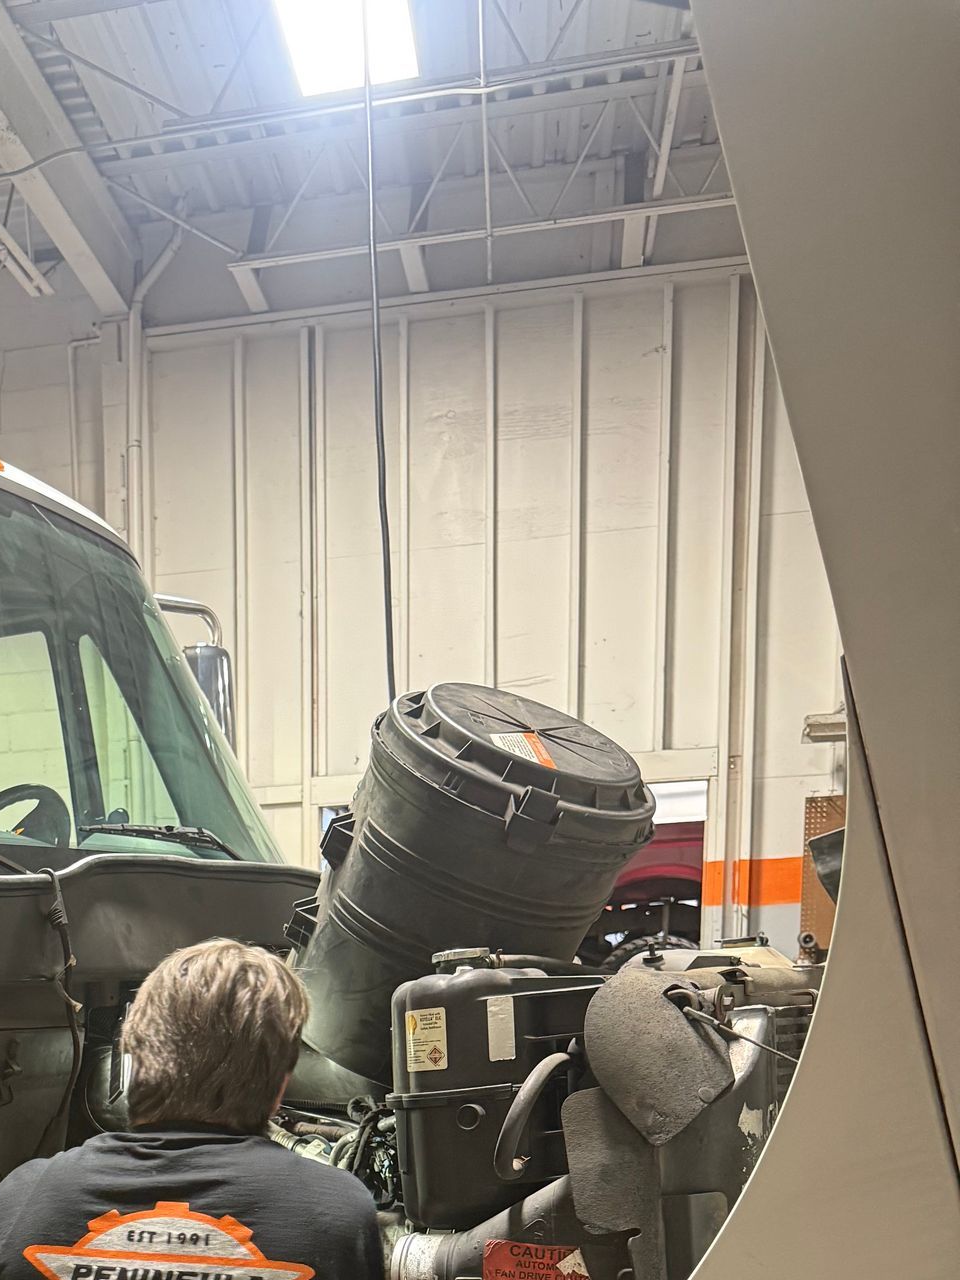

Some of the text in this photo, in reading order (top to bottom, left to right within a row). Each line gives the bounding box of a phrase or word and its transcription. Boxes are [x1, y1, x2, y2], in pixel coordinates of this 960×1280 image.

[127, 1229, 210, 1246] EST 1991
[515, 1260, 559, 1271] AUTOM
[495, 1269, 515, 1278] FAN
[519, 1271, 552, 1280] DRIVE
